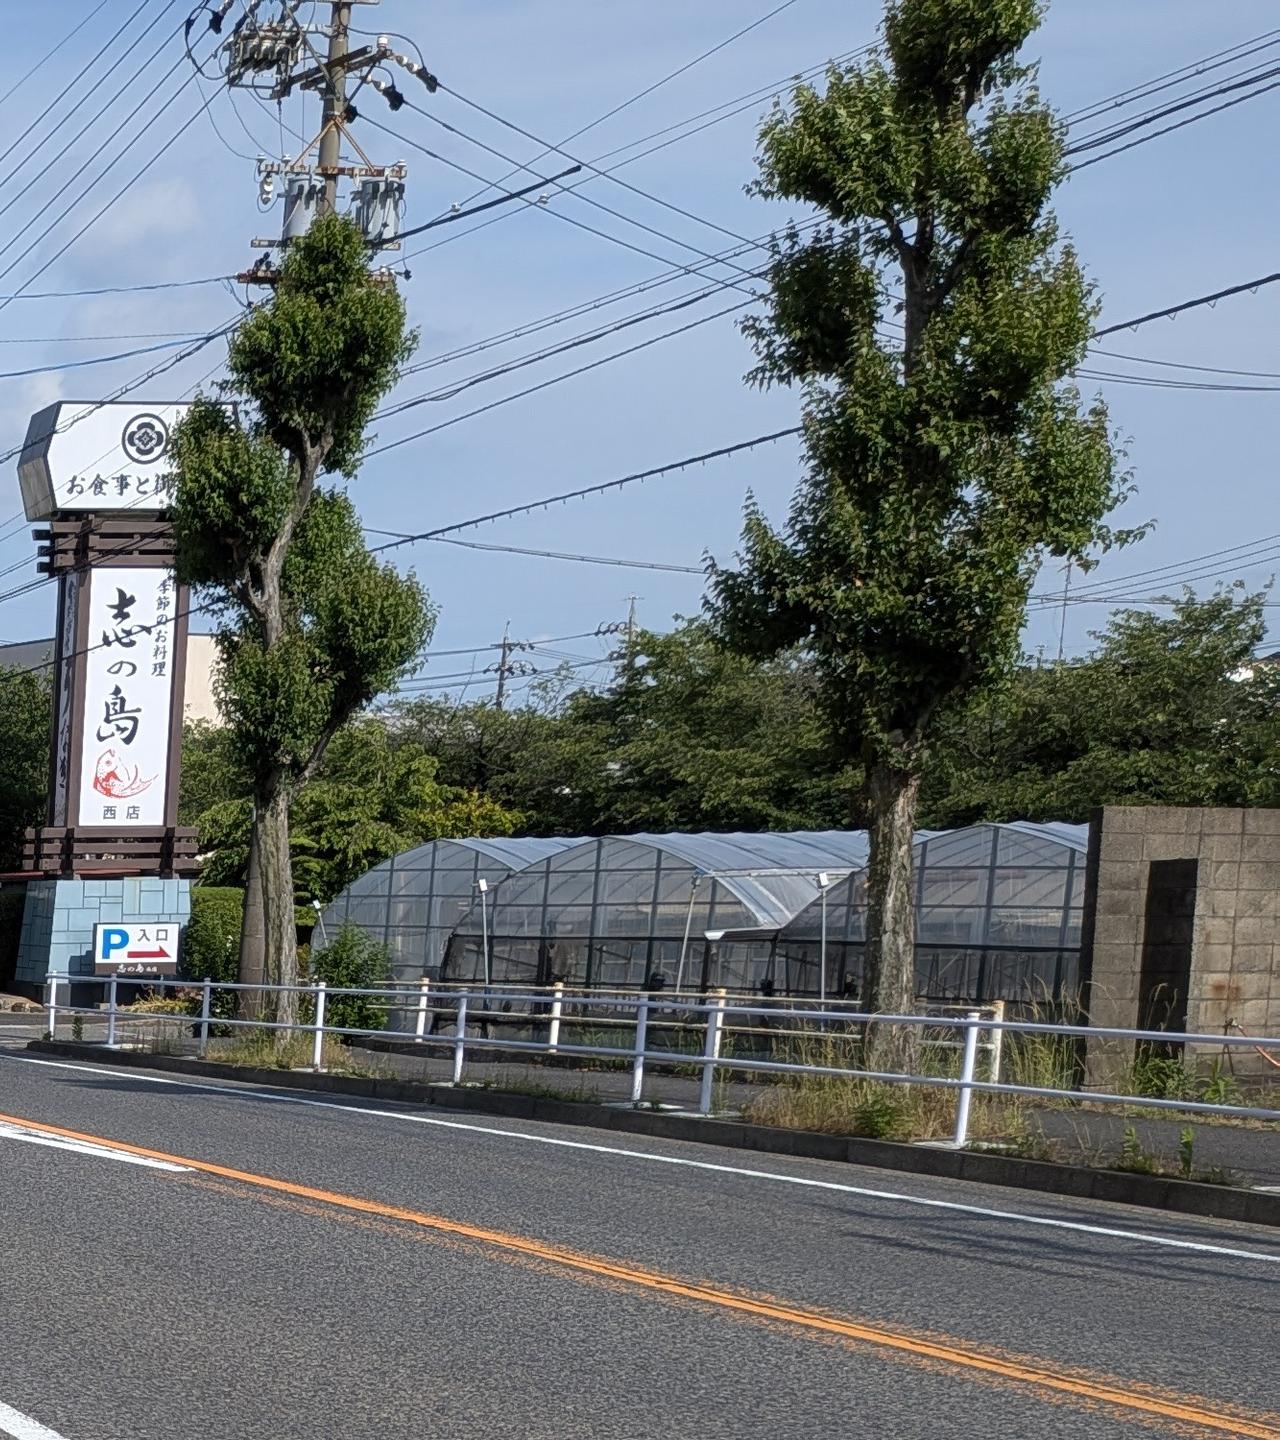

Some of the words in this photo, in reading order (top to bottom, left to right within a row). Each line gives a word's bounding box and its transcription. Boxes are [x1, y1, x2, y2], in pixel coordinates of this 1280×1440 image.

[96, 587, 152, 746] 志の島
[102, 805, 140, 820] 西店
[102, 928, 129, 959] P
[137, 929, 168, 942] 入口
